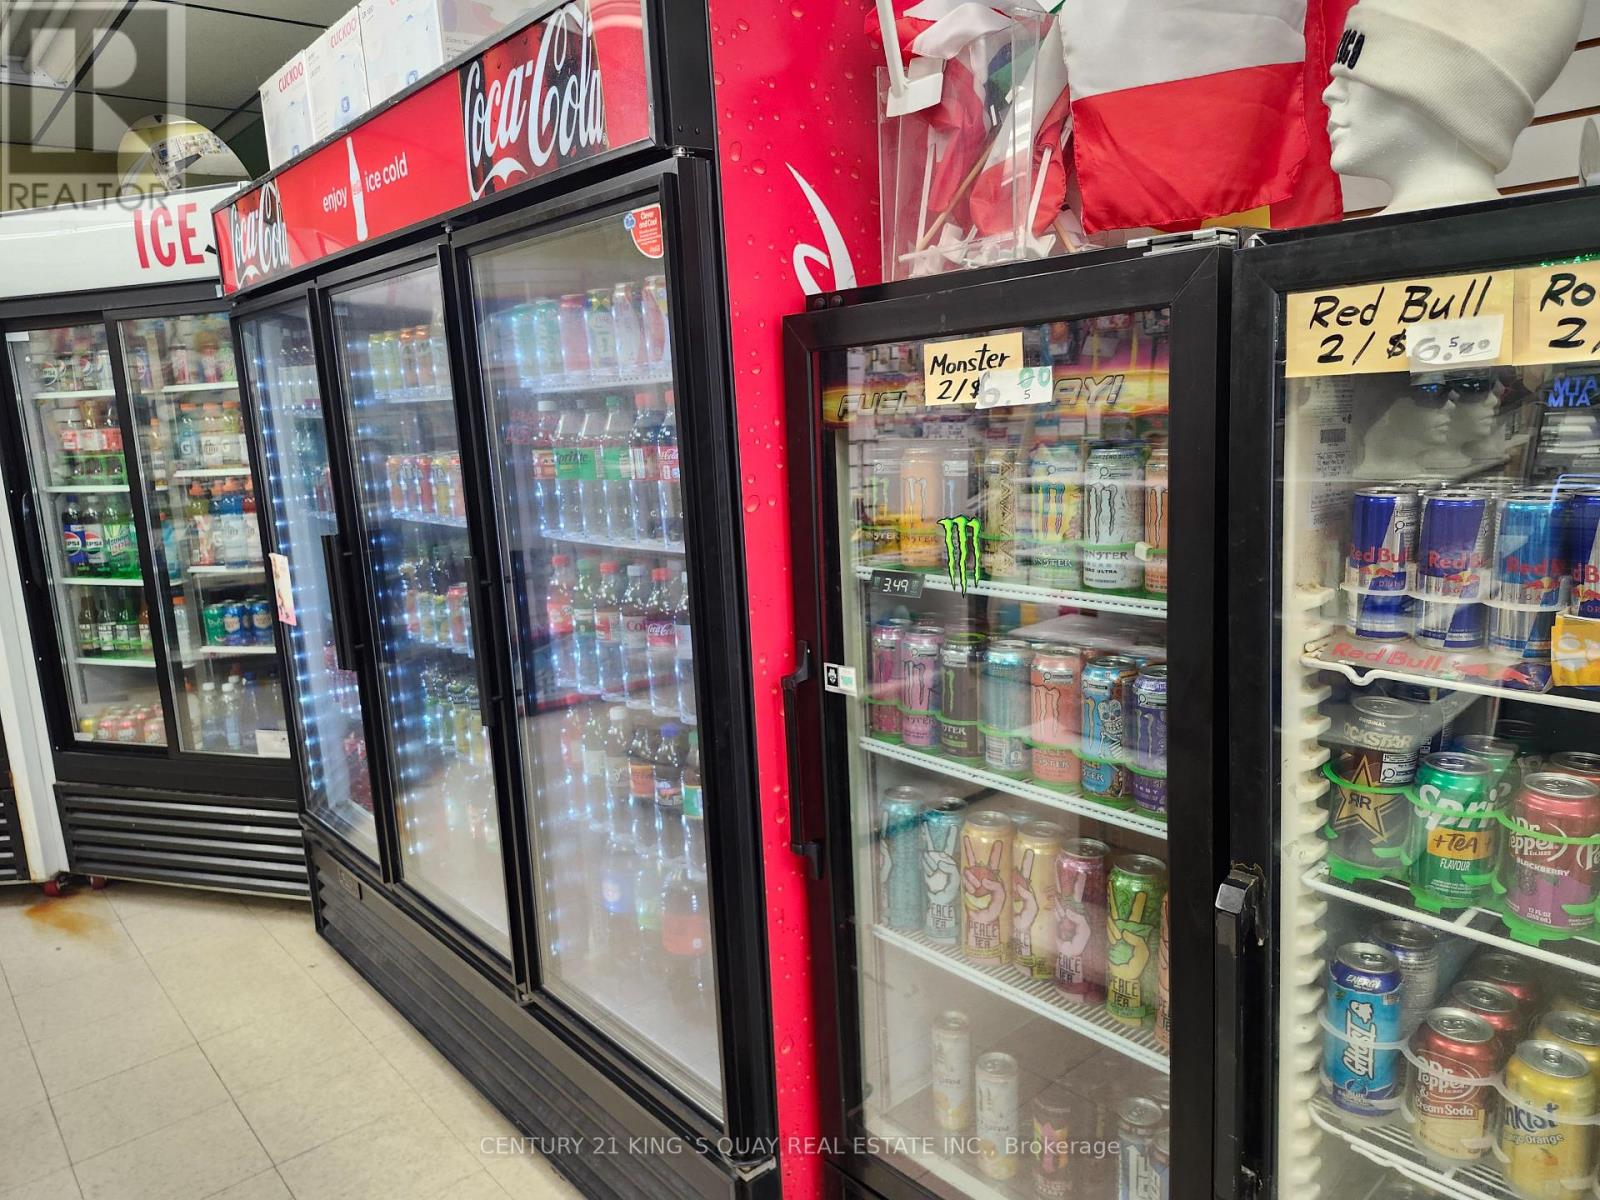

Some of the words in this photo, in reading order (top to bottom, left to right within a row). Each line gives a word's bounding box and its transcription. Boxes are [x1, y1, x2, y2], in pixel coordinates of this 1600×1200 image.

[330, 16, 358, 49] CUCKOO
[278, 61, 304, 93] CUCKOO
[464, 3, 603, 201] Coca-Cola
[323, 187, 347, 213] enjoy
[364, 170, 382, 193] ice
[382, 152, 408, 185] cold
[133, 202, 206, 269] ICE
[230, 181, 290, 290] Coca-Cola
[1309, 286, 1385, 329] Red
[1397, 275, 1493, 325] Bull
[930, 344, 1010, 375] Monster
[837, 390, 917, 421] FUEL
[1428, 550, 1466, 569] Red
[1506, 556, 1547, 577] Red
[882, 577, 909, 593] 3.49
[1331, 639, 1385, 661] Red
[1387, 646, 1443, 674] Bull
[1440, 858, 1470, 872] FLAVOUR
[968, 920, 998, 938] PEACE
[1444, 1103, 1474, 1116] Soda
